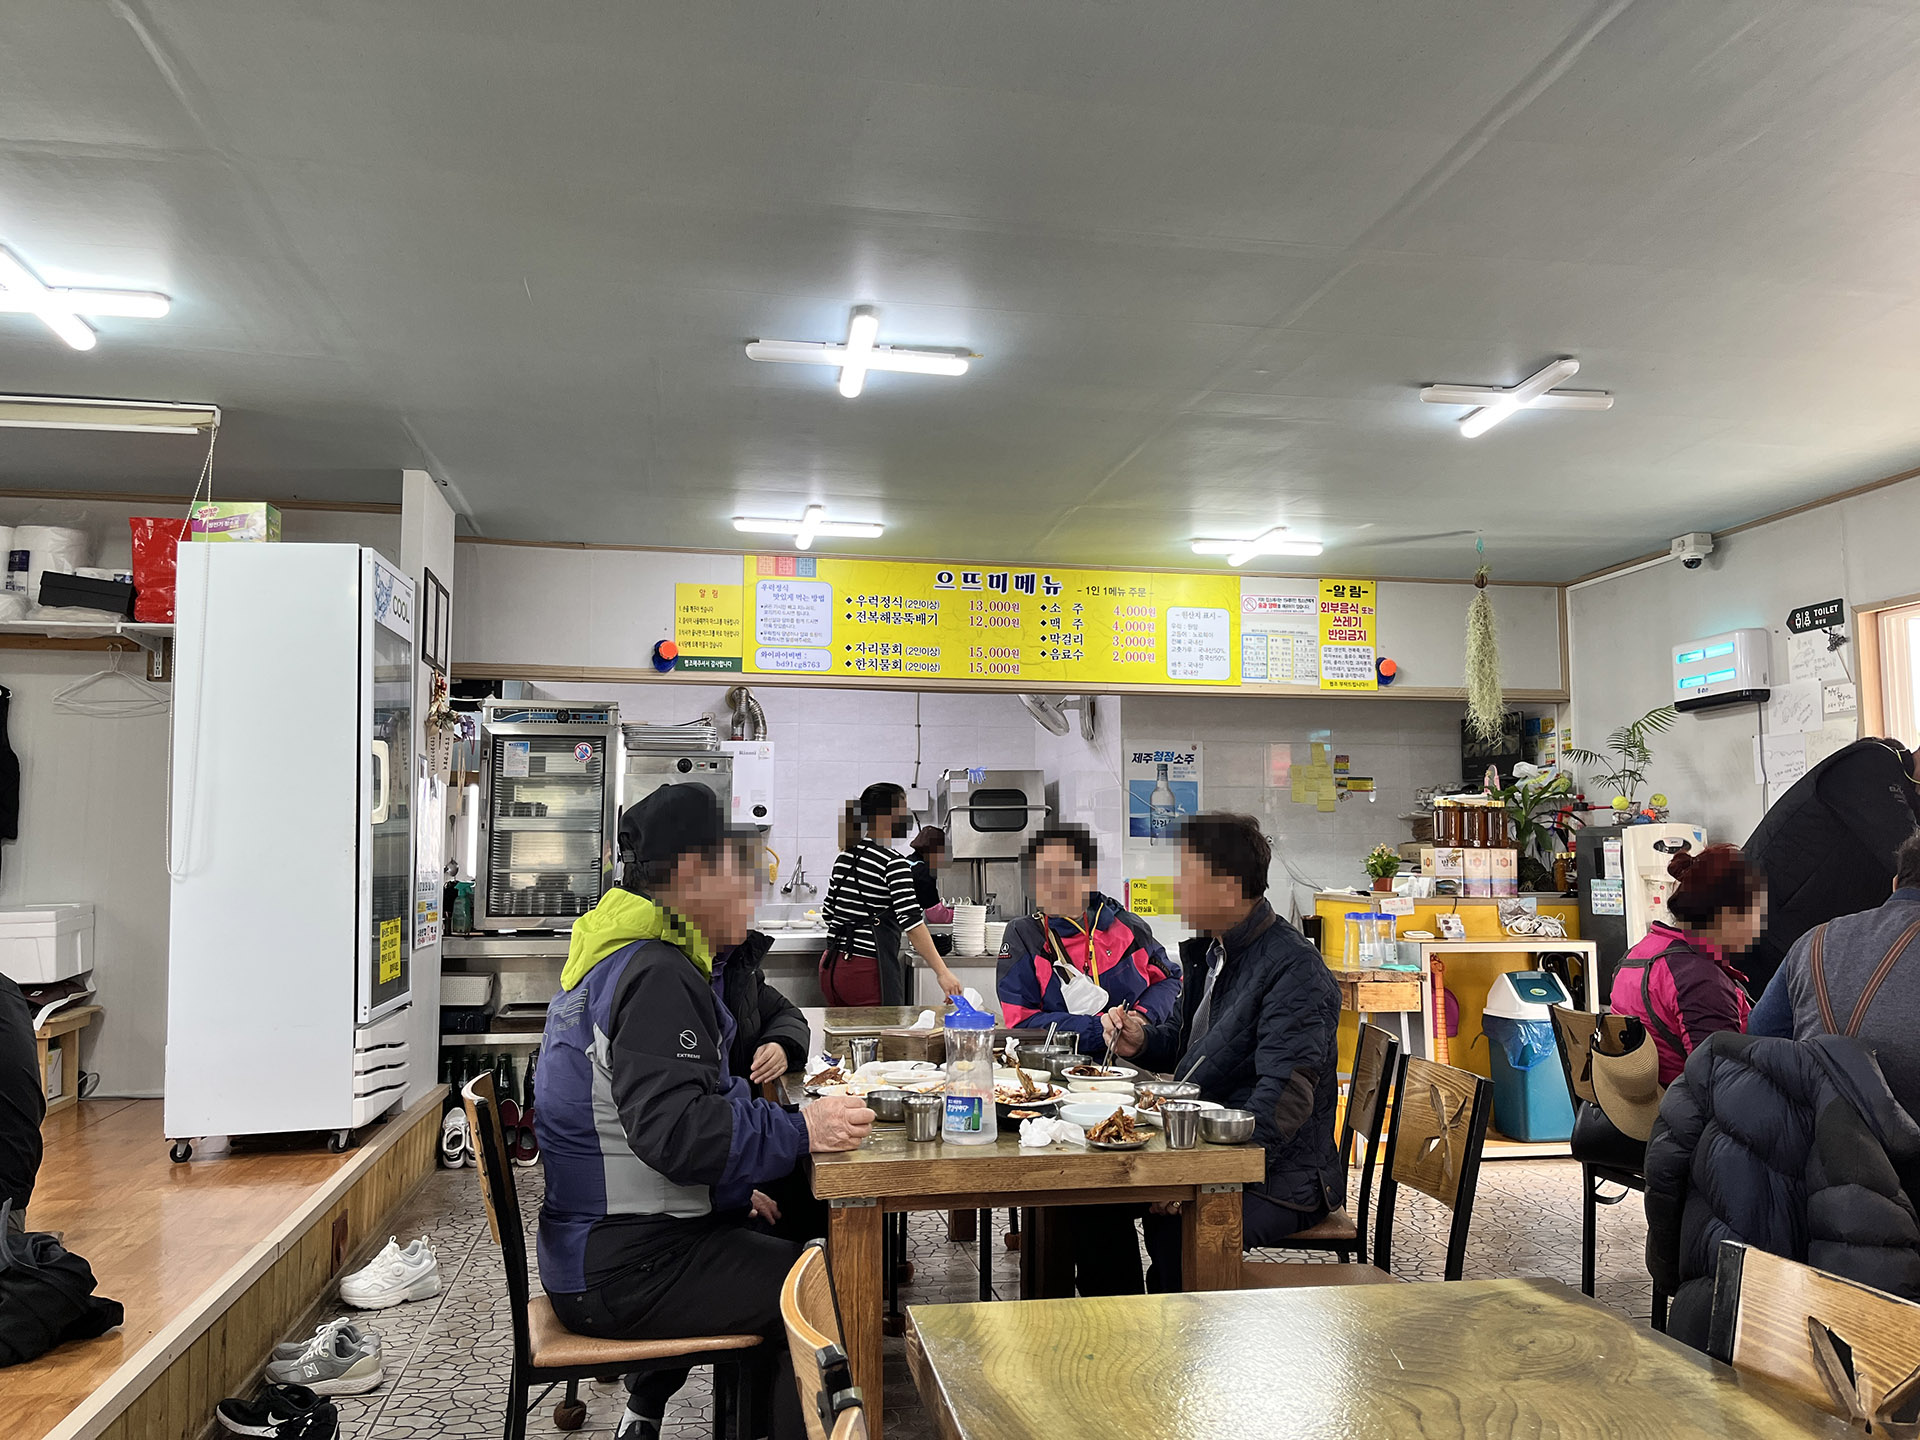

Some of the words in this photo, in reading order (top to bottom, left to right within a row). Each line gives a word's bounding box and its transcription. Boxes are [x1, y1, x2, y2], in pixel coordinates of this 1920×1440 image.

[773, 593, 794, 601] 맛있게
[796, 594, 809, 602] 먹는
[1086, 586, 1100, 596] 1인
[1104, 587, 1126, 596] 1메뉴
[1129, 587, 1146, 597] 주문
[856, 595, 902, 609] 우럭정식
[905, 600, 940, 610] (2인이상)
[1320, 602, 1359, 614] 외부음식
[1182, 611, 1201, 619] 원산지
[1203, 612, 1216, 620] 표시
[1814, 605, 1838, 616] TOILET
[856, 610, 938, 626] 전복해물뚝배기
[1333, 616, 1362, 628] 쓰레기
[1050, 633, 1084, 645] 막걸리
[1328, 630, 1366, 641] 반입금지
[855, 642, 902, 656] 자리물회
[905, 647, 940, 657] (2인이상)
[1050, 648, 1084, 661] 음료수
[711, 660, 732, 668] 감사합니다
[855, 658, 902, 672] 한치물회
[905, 663, 940, 672] (2인이상)
